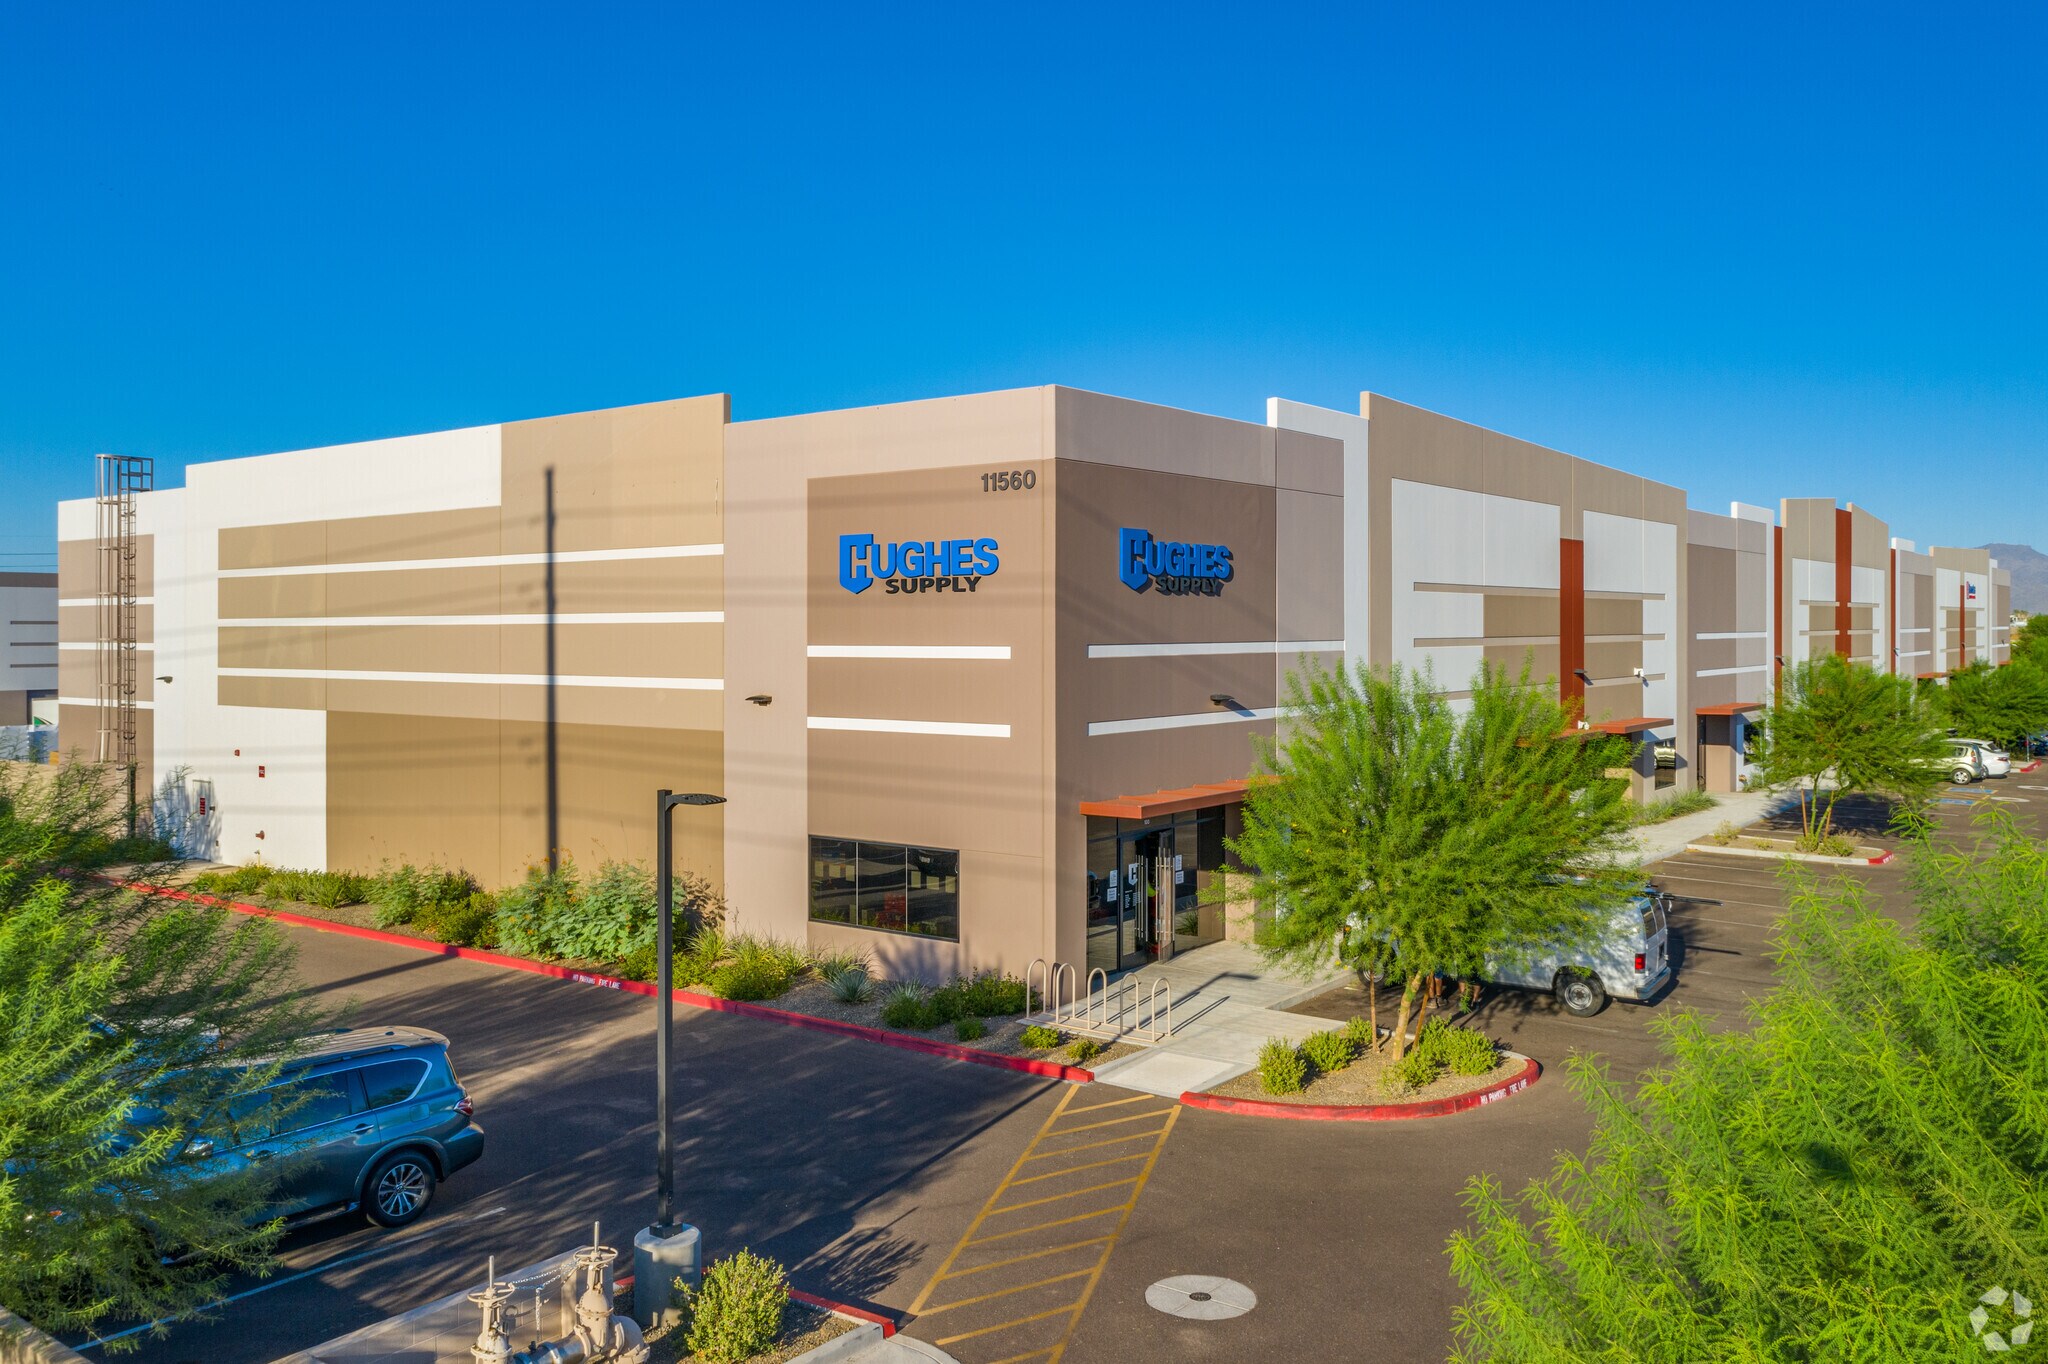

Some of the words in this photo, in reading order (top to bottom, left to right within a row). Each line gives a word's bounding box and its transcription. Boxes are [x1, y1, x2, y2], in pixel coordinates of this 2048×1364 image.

[981, 469, 1036, 492] 11560
[839, 534, 999, 594] HUGHES
[1119, 527, 1230, 590] HUGHES
[885, 576, 981, 594] SUPPLY
[1155, 576, 1219, 594] SUPPLY
